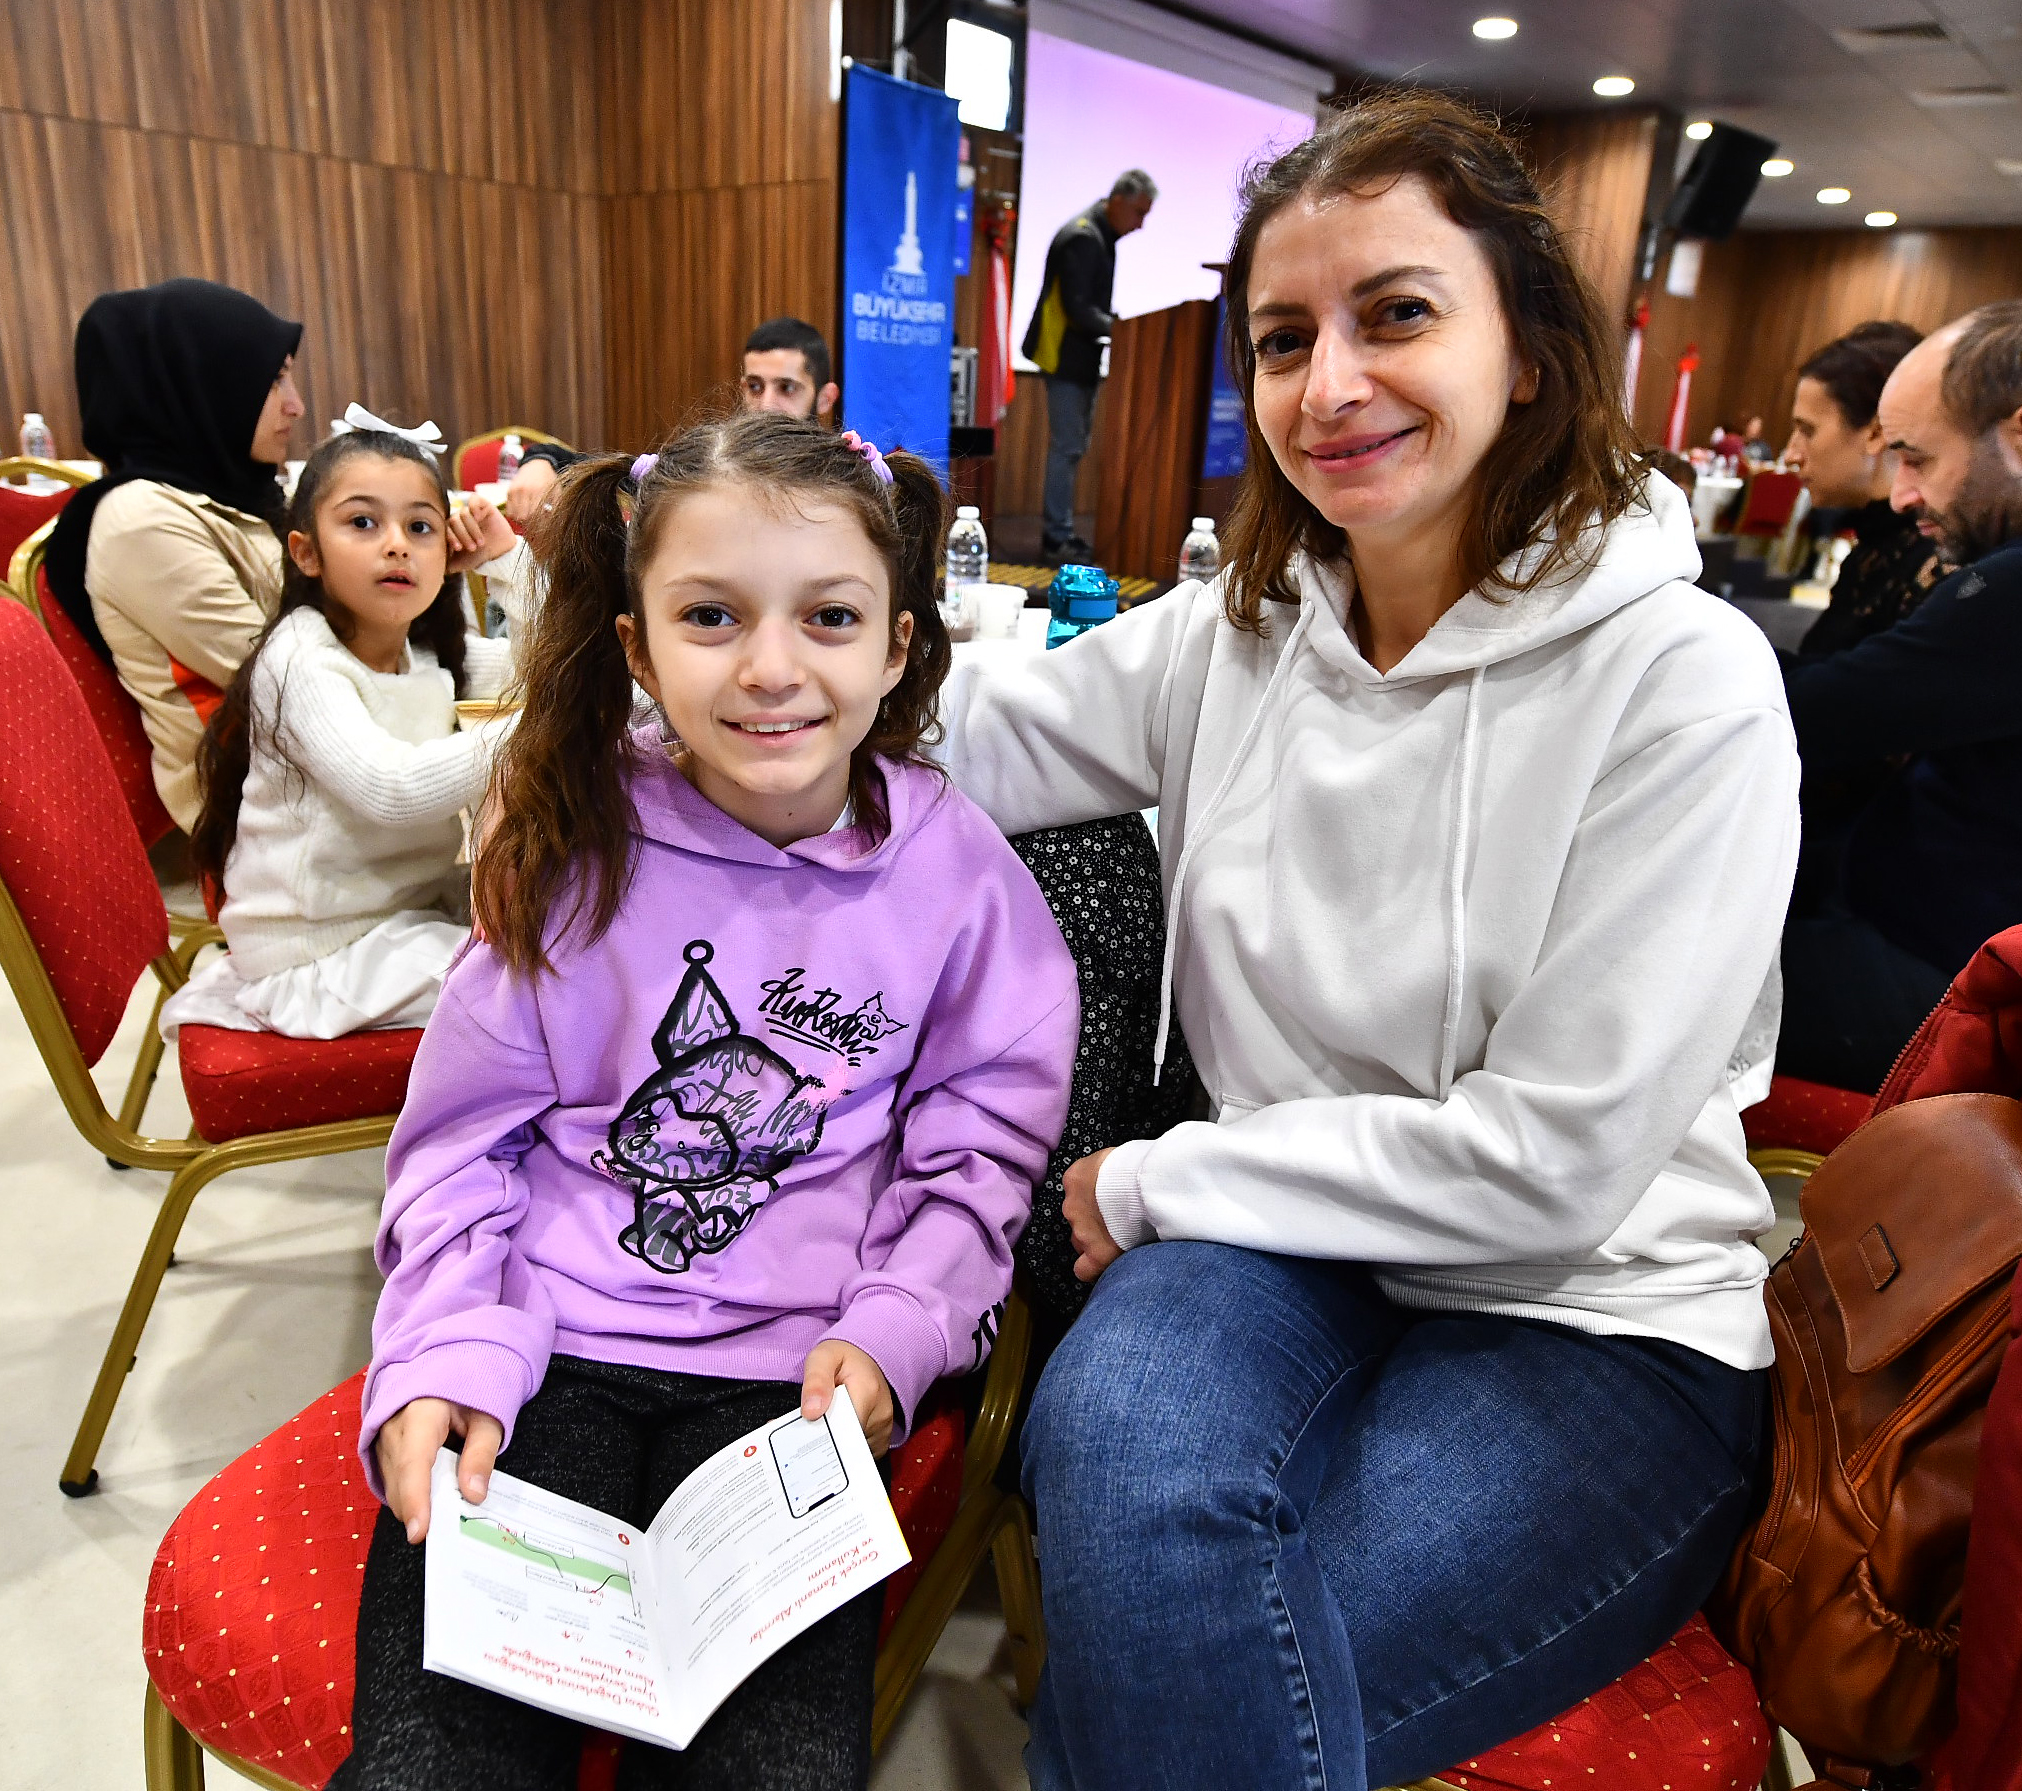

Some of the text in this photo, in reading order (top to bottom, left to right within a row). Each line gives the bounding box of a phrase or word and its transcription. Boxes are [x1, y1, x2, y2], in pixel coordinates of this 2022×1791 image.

[807, 1537, 873, 1582] ve Kullanımı
[840, 1550, 878, 1579] Gerçek
[794, 1576, 837, 1609] Zamanlı
[750, 1605, 791, 1645] Alarmlar
[624, 1669, 654, 1688] Alarm
